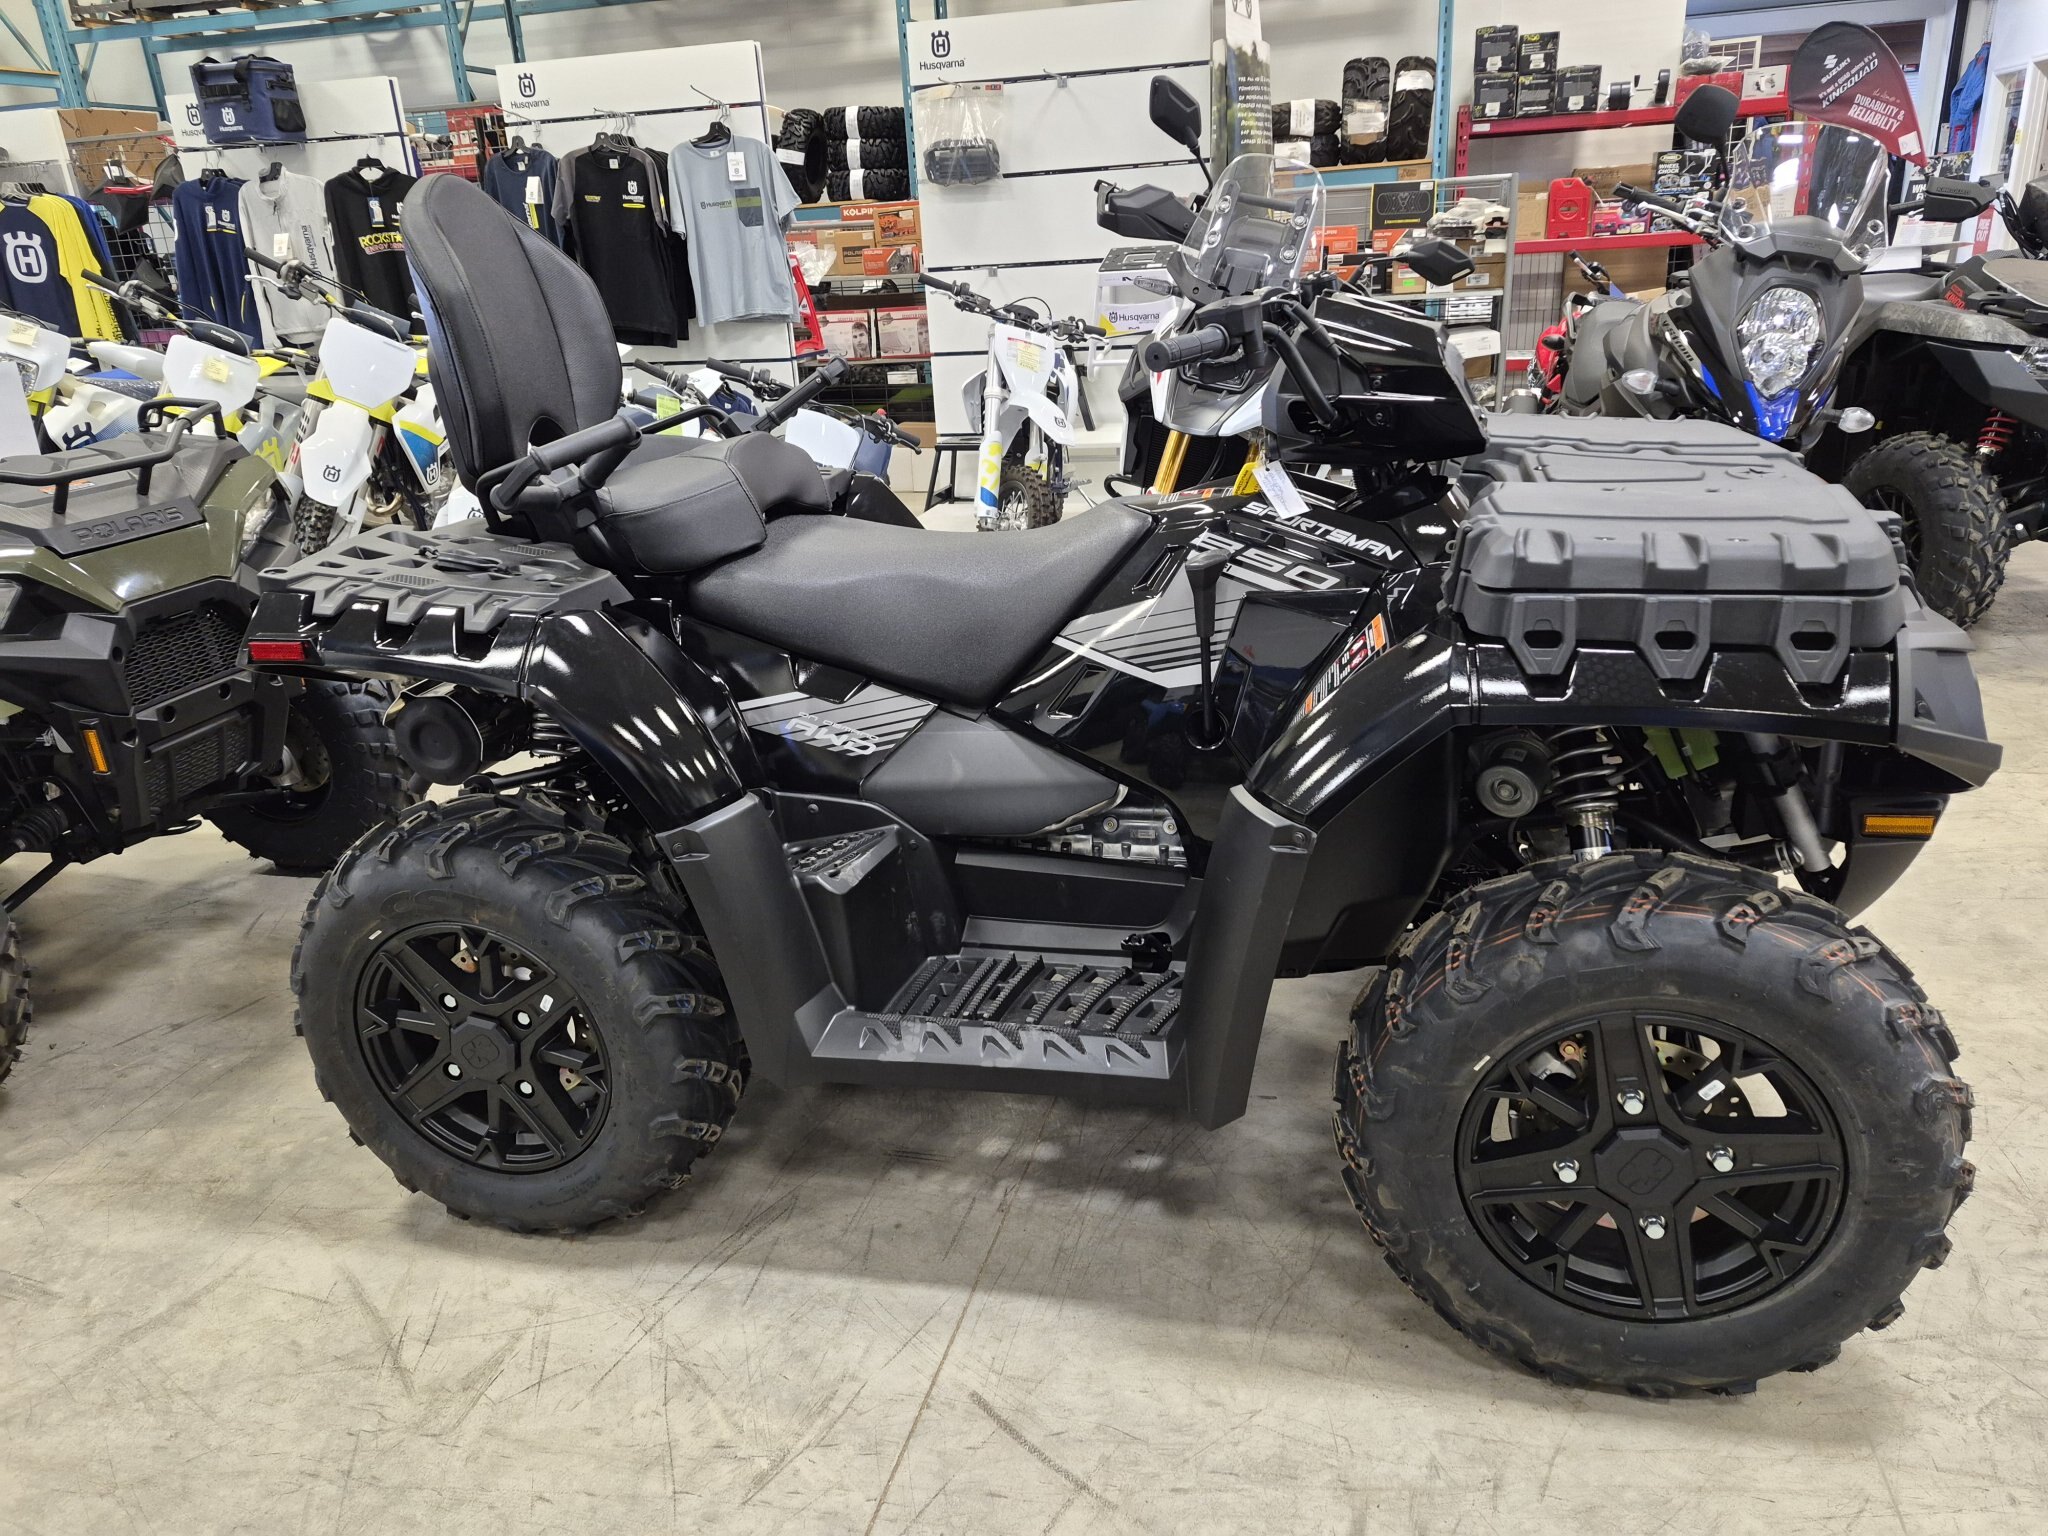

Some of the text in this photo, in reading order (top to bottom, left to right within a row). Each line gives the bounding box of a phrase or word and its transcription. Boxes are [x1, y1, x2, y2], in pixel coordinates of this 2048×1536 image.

[919, 59, 965, 70] Husqvarna
[1820, 57, 1851, 84] SUZUKI
[1821, 58, 1879, 109] KINGQUAD
[1837, 71, 1851, 84] QUAD
[510, 99, 550, 109] Husqvarna
[1854, 93, 1899, 117] DURABILITY
[1896, 109, 1905, 121] &
[1847, 104, 1901, 133] RELIABILTY
[181, 127, 205, 137] Husqv
[218, 125, 244, 133] Husqvarna
[1976, 230, 1989, 241] OUT
[1119, 313, 1160, 323] Husqvarna
[72, 505, 185, 546] POLARIS
[784, 717, 877, 756] AWD
